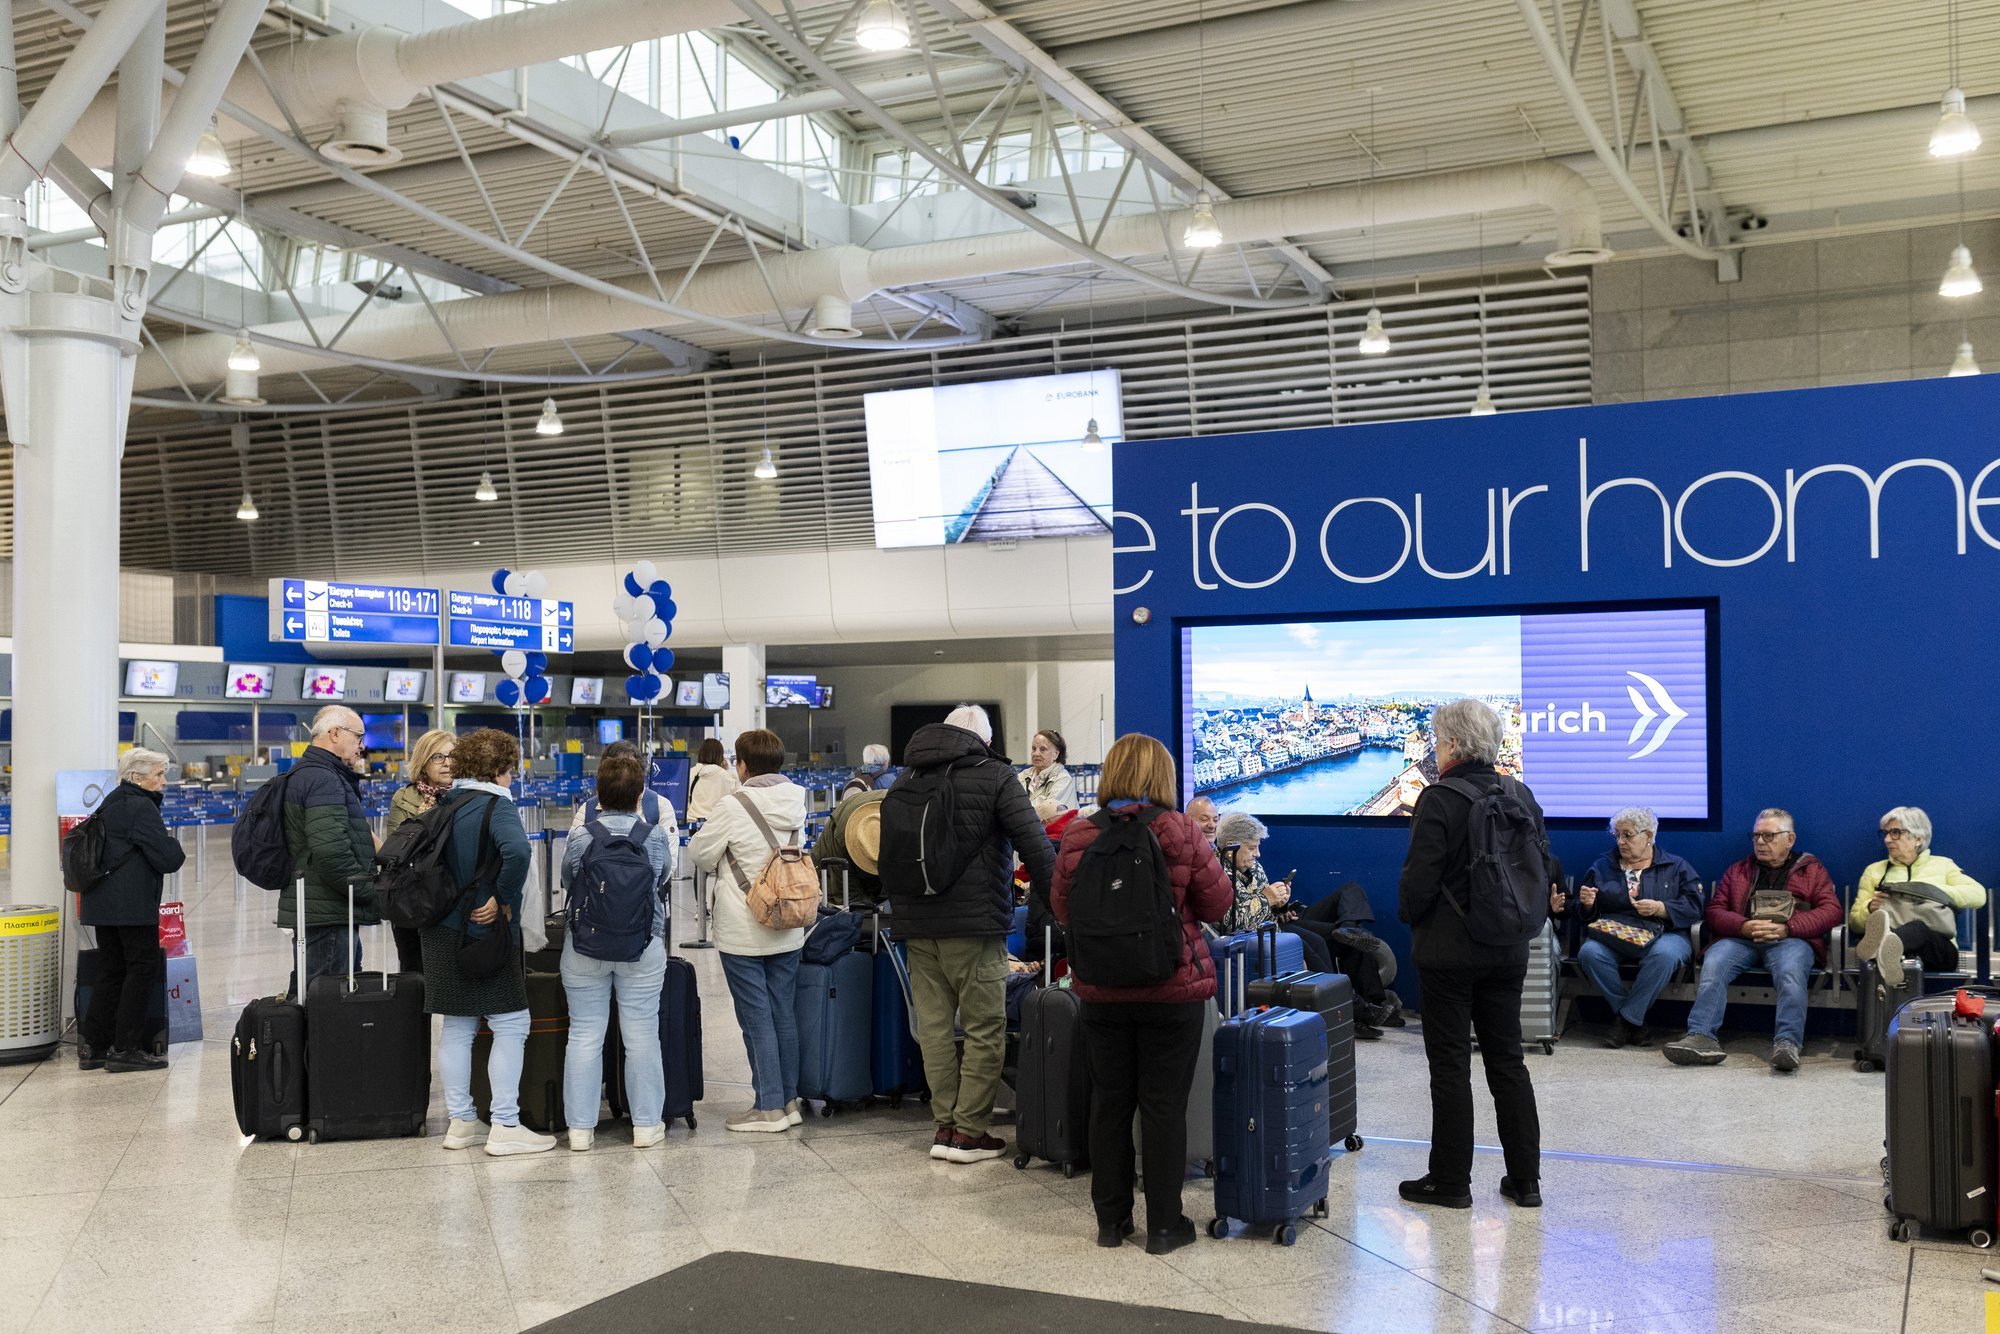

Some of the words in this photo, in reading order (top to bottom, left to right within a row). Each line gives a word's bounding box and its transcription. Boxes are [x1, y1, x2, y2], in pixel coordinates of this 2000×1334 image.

[1056, 390, 1099, 400] EUROBANK
[1181, 482, 1296, 589] to
[1320, 485, 1548, 583] our
[329, 598, 353, 609] Check-in
[387, 589, 437, 613] 119-171
[451, 604, 473, 615] Check-in
[500, 598, 532, 620] 1-118
[332, 628, 351, 638] Toilets
[470, 635, 487, 646] Airport
[487, 636, 514, 647] Information
[4, 920, 40, 930] Πλαστικά
